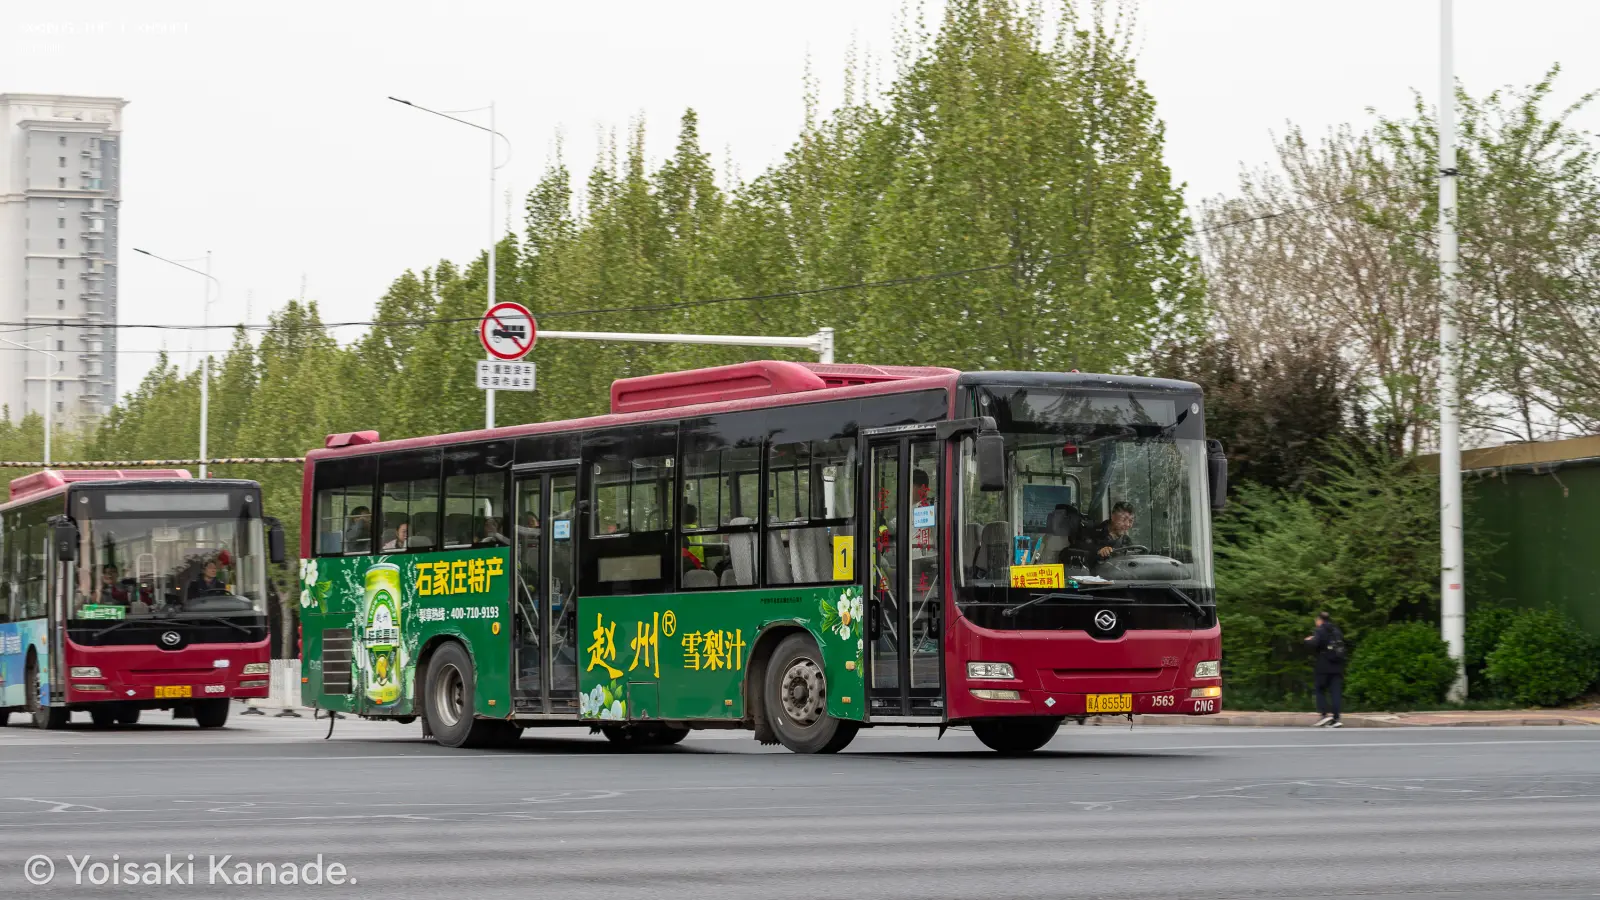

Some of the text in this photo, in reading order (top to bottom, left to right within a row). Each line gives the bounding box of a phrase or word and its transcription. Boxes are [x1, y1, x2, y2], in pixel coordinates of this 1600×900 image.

[841, 547, 847, 568] 1
[415, 557, 503, 596] 石家庄特产
[681, 629, 746, 671] 雪梨汁
[1194, 700, 1213, 712] CNG
